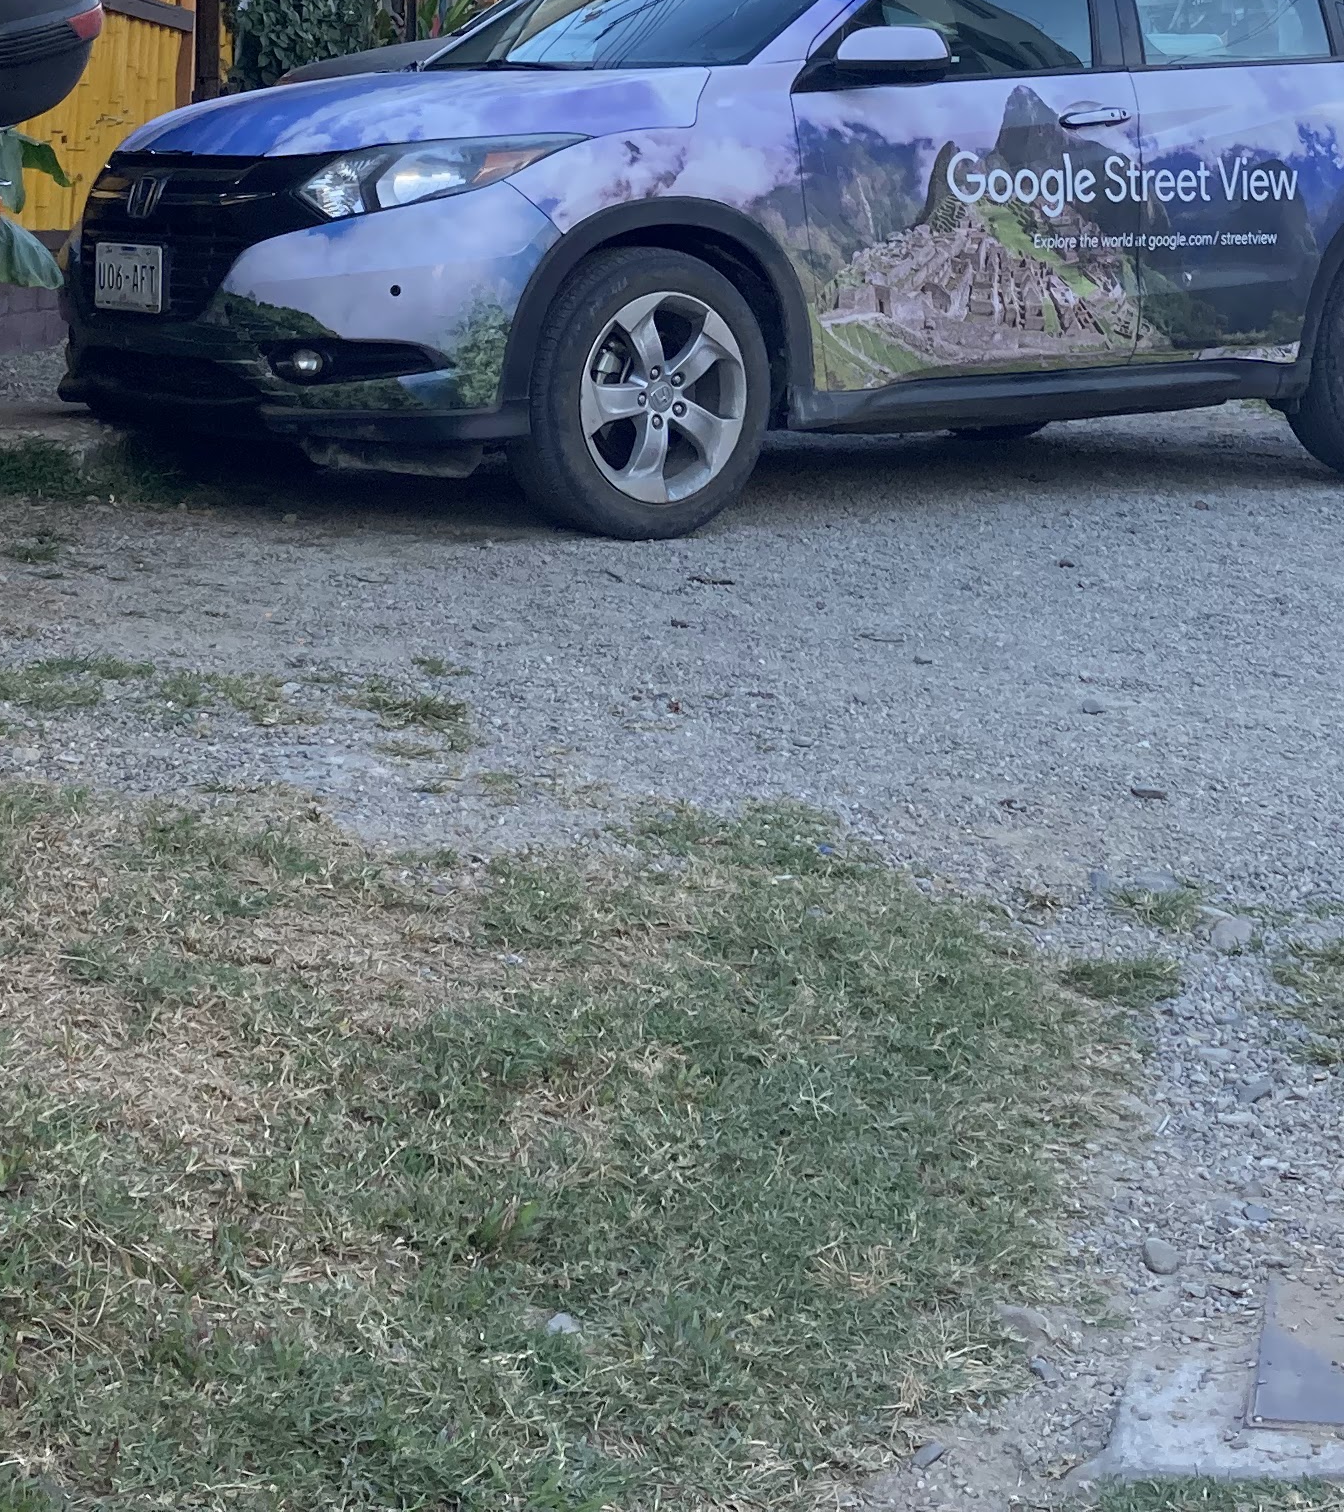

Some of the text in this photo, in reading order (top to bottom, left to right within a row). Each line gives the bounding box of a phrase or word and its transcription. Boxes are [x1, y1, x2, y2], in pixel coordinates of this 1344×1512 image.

[946, 150, 1299, 217] Google Street View
[1033, 234, 1076, 252] Explore
[1079, 233, 1098, 248] the
[1100, 232, 1133, 248] world
[1134, 233, 1147, 248] at
